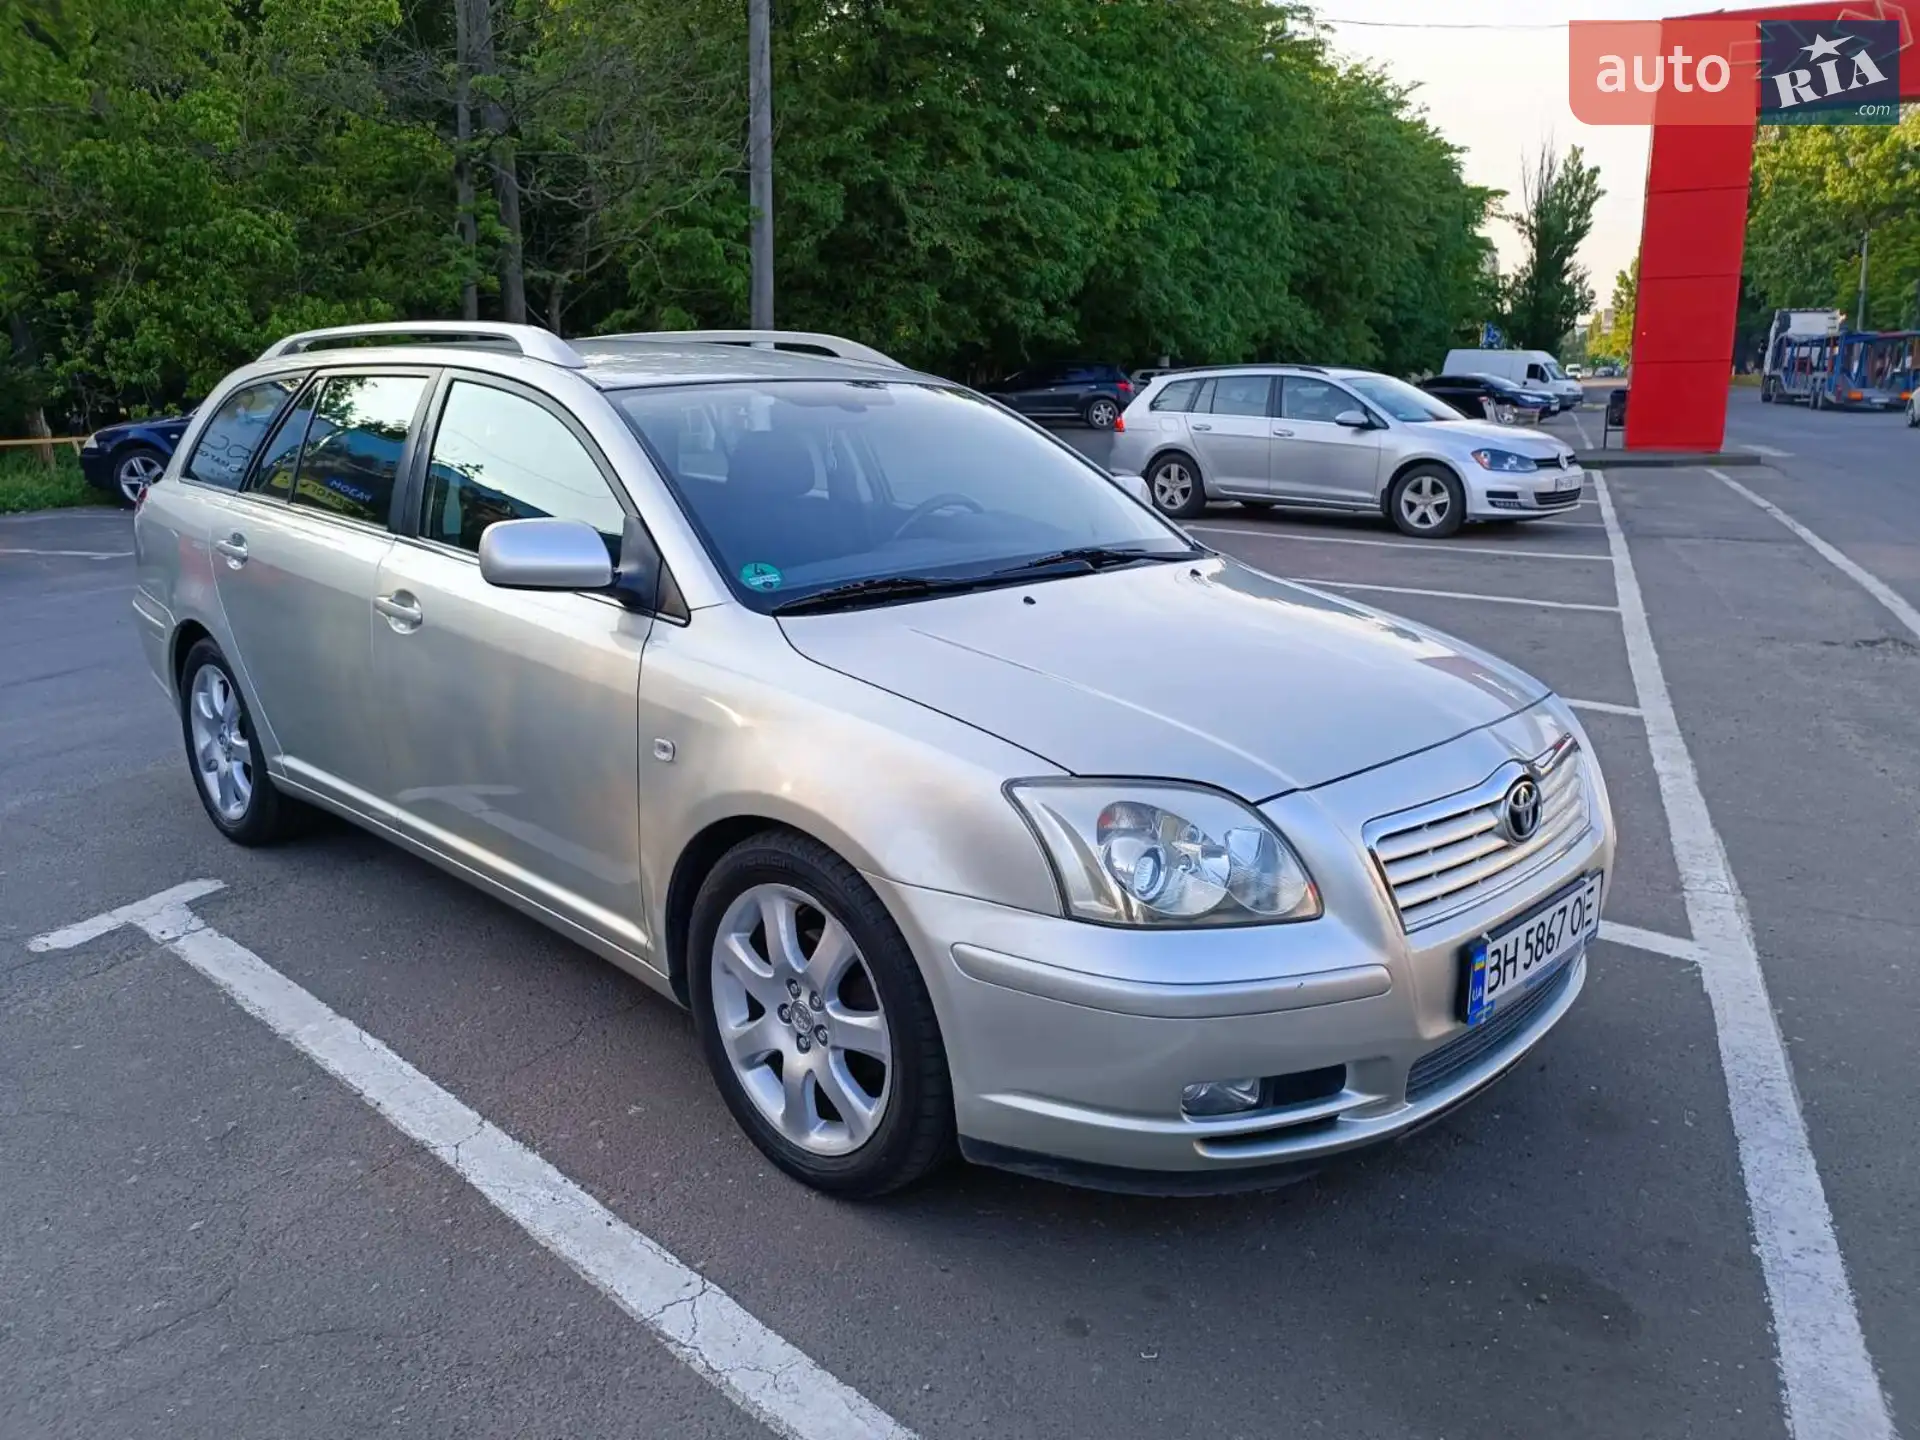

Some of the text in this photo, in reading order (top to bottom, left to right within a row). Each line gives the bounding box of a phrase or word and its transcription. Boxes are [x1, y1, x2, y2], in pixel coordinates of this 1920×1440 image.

[1487, 886, 1595, 995] BH 5867 OE
